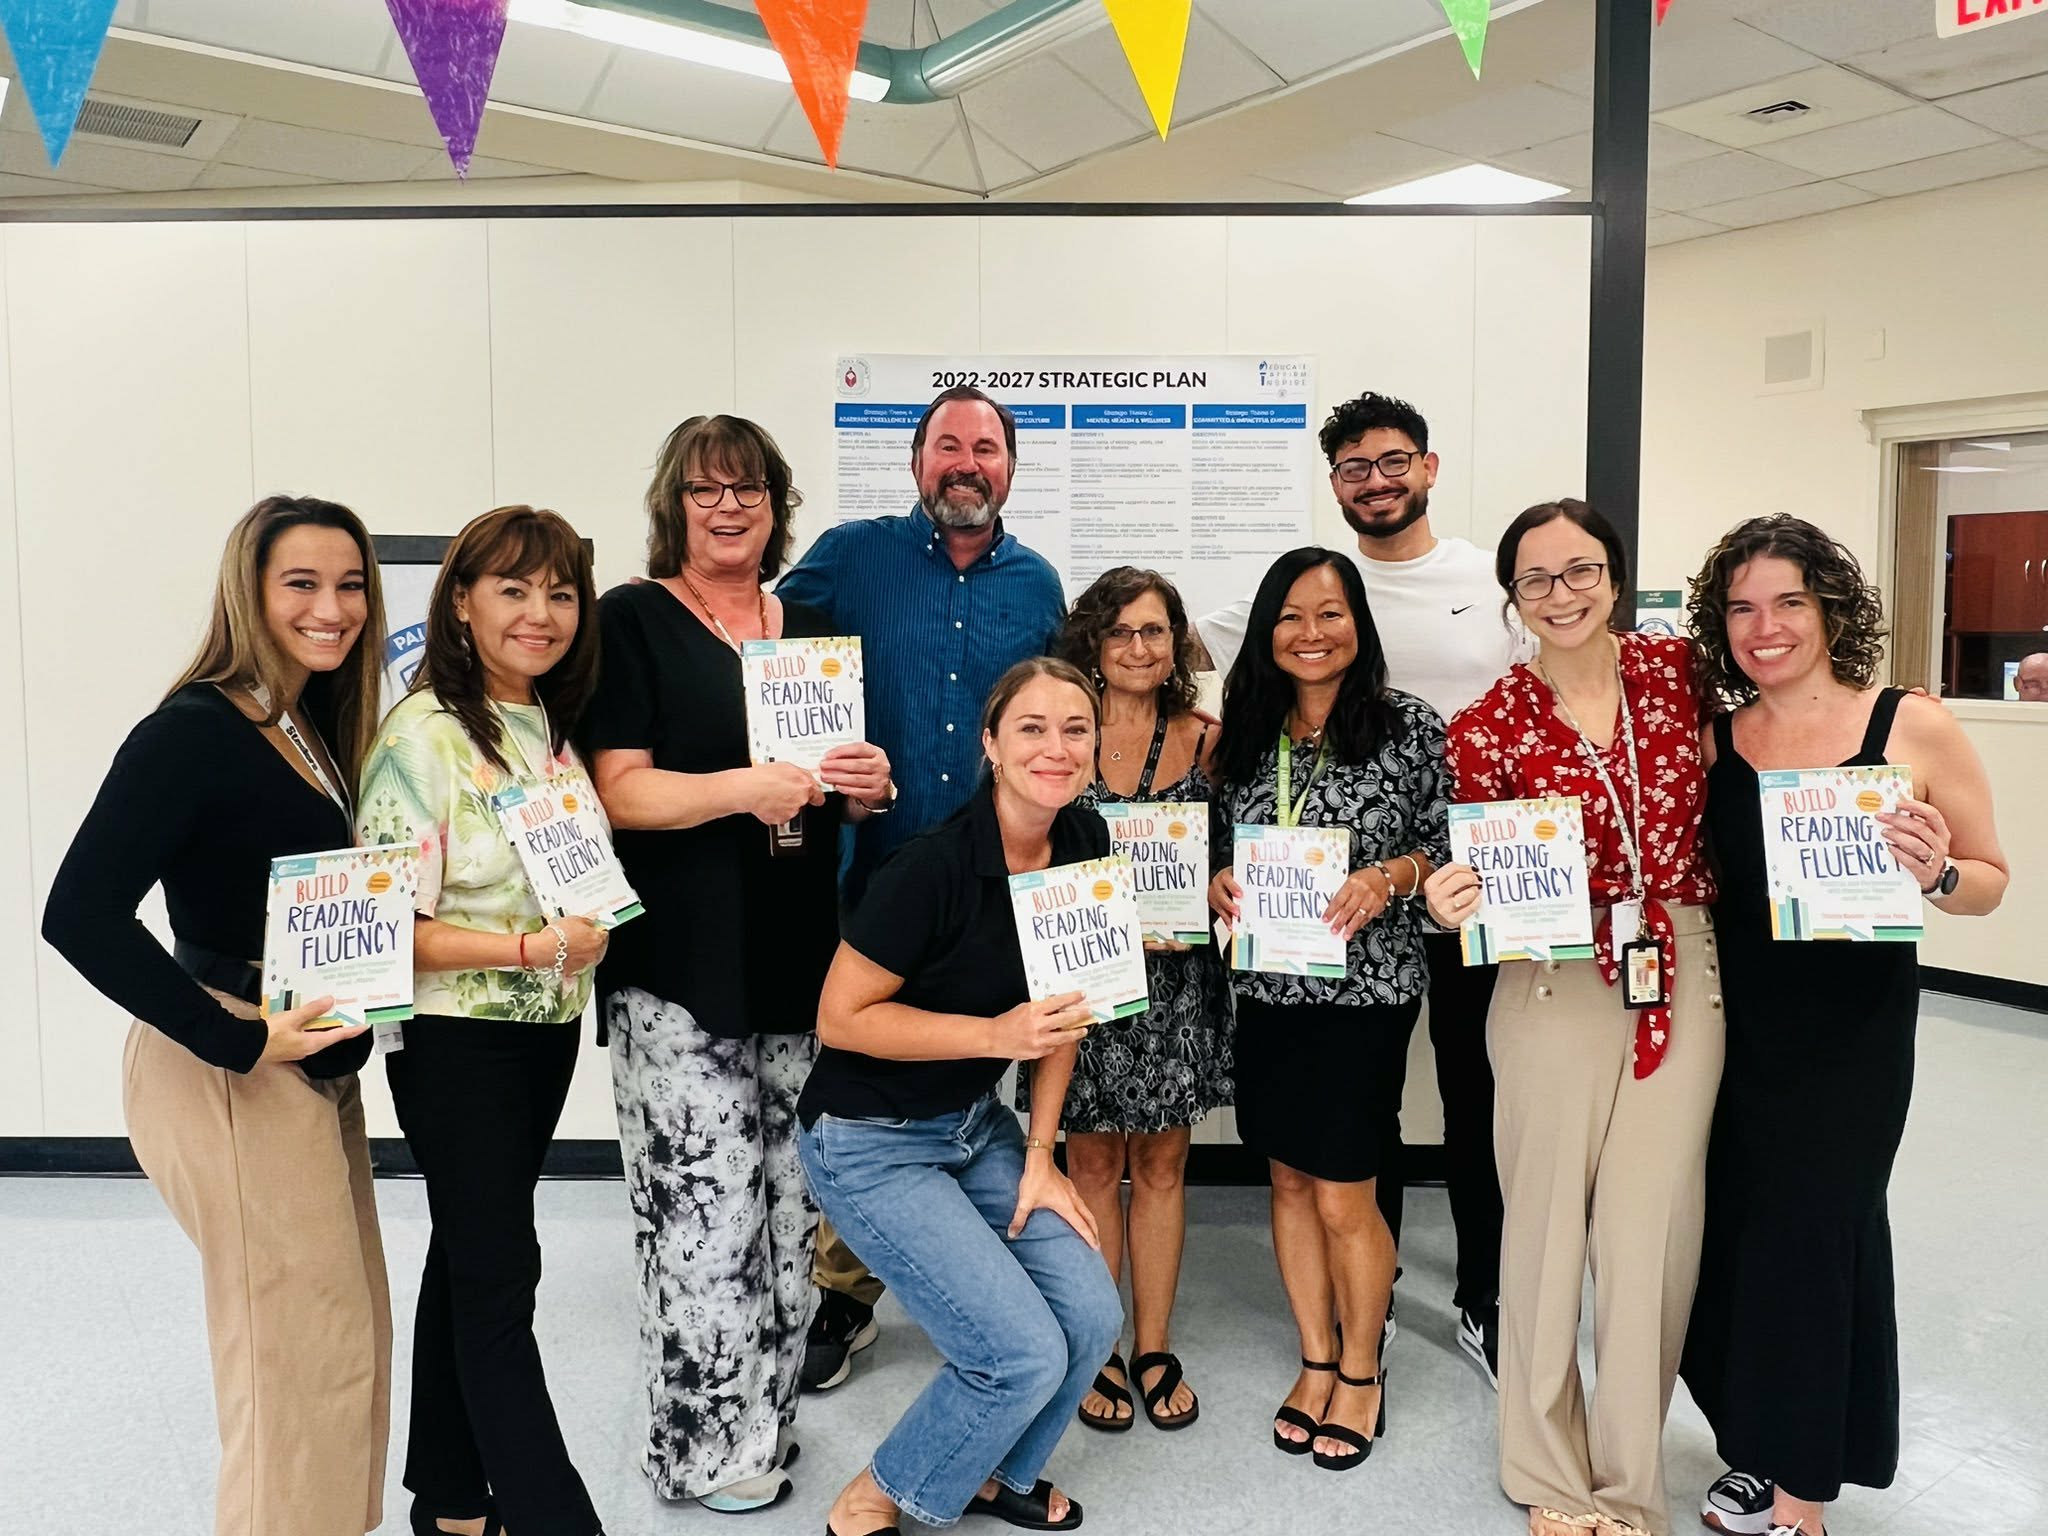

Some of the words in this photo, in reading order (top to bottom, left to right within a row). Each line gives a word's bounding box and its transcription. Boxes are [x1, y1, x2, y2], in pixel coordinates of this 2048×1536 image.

[932, 371, 1035, 388] 2022-2027
[1039, 371, 1148, 388] STRATEGIC
[1153, 371, 1207, 388] PLAN
[763, 655, 806, 681] BUILD
[760, 680, 834, 706] READING
[776, 702, 853, 739] FLUENCY
[519, 797, 554, 829] BUILD
[1783, 787, 1837, 815] BUILD
[525, 817, 583, 856] READING
[1115, 818, 1154, 840] BUILD
[1470, 819, 1517, 845] BUILD
[1781, 815, 1873, 843] READING
[547, 835, 607, 887] FLUENCY
[1250, 842, 1290, 863] BUILD
[1468, 844, 1550, 871] READING
[1800, 841, 1900, 880] FLUENC
[296, 872, 349, 904] BUILD
[1133, 862, 1197, 892] LUENCY
[1246, 863, 1315, 891] READING
[1485, 866, 1573, 905] FLUENCY
[1032, 882, 1077, 914] BUILD
[288, 898, 378, 933] READING
[1032, 904, 1108, 941] READING
[302, 920, 399, 969] FLUENCY
[1052, 923, 1130, 974] FLUENCY
